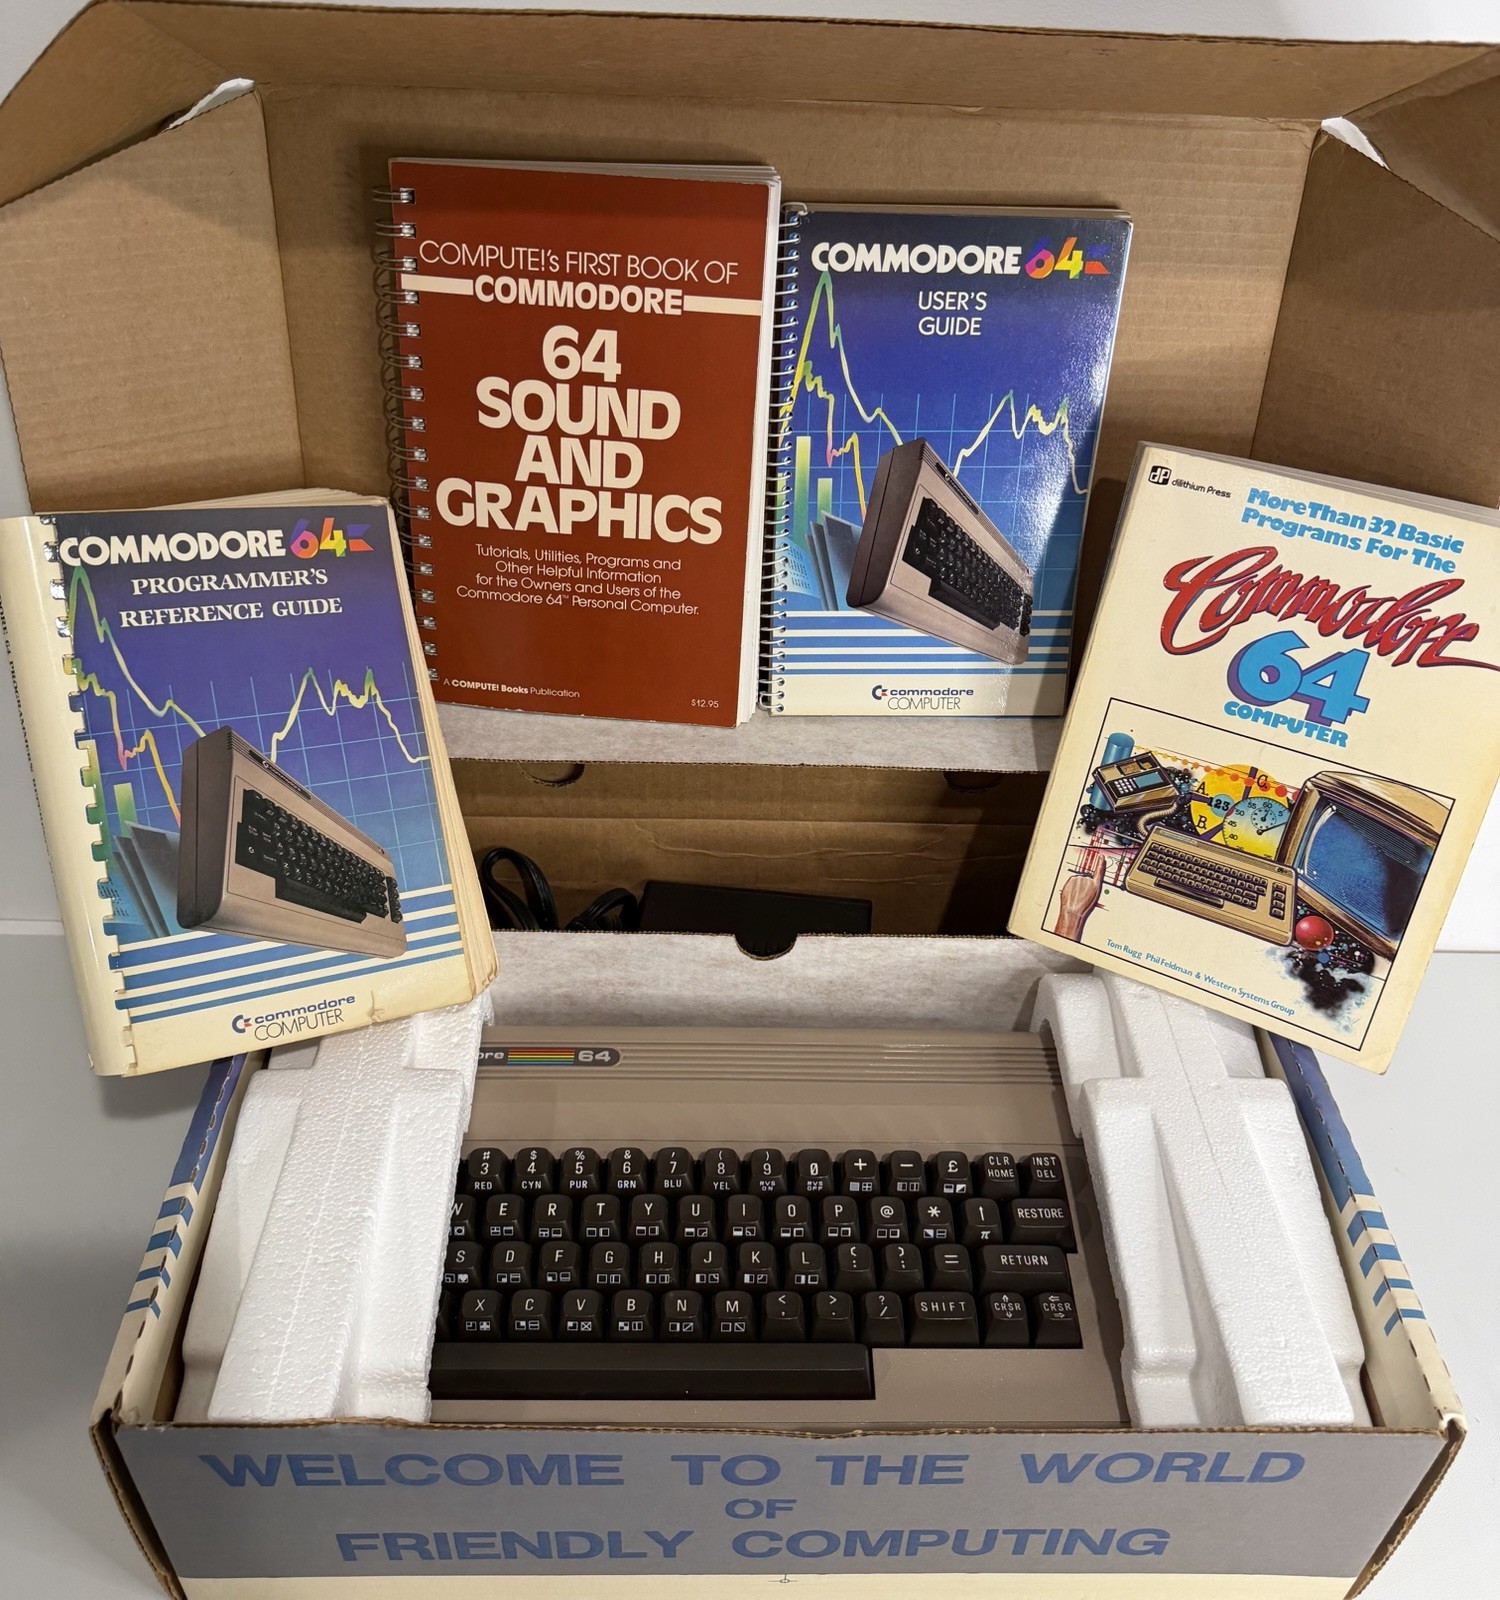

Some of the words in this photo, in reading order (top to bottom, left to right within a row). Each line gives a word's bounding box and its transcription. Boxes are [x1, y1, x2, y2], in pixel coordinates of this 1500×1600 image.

[419, 239, 560, 273] COMPUTE!'s
[566, 250, 622, 277] FIRST
[627, 256, 699, 283] BOOK
[703, 260, 739, 285] OF
[811, 242, 1022, 276] COMMODORE
[1024, 235, 1084, 280] 64
[474, 274, 683, 316] COMMODORE
[917, 290, 988, 312] USER'S
[918, 316, 982, 337] GUIDE
[542, 324, 622, 383] 64
[476, 375, 682, 441] SOUND
[514, 434, 644, 490] AND
[1171, 478, 1206, 493] dilithium
[1206, 485, 1232, 499] Press
[435, 477, 723, 545] GRAPHICS
[1246, 487, 1307, 516] More
[1307, 501, 1367, 531] Than
[1368, 515, 1397, 538] 32
[1397, 522, 1465, 554] Basic
[58, 528, 287, 567] COMMODORE
[289, 516, 348, 560] 64
[1240, 506, 1362, 551] Programs
[1364, 537, 1408, 561] For
[1411, 547, 1457, 574] The
[475, 543, 531, 561] Tutorials,
[534, 549, 582, 565] Utilities,
[585, 552, 650, 569] Programs
[652, 558, 682, 571] and
[495, 560, 533, 575] Other
[536, 563, 583, 580] Helpful
[586, 567, 662, 584] Information
[130, 567, 329, 597] PROGRAMMER'S
[475, 573, 493, 586] for
[496, 574, 518, 588] the
[521, 577, 572, 593] Owners
[574, 581, 603, 595] and
[606, 584, 641, 598] Users
[643, 586, 658, 599] of
[659, 587, 682, 600] the
[456, 585, 543, 605] Commodore
[571, 595, 627, 611] Personal
[630, 599, 700, 617] Computer.
[118, 601, 265, 629] REFERENCE
[271, 597, 344, 618] GUIDE
[1159, 545, 1500, 671] Commodore
[1226, 630, 1371, 727] 64
[443, 678, 450, 687] A
[451, 679, 500, 693] COMPUTE!
[501, 684, 529, 695] Books
[530, 687, 580, 699] Publication
[889, 687, 974, 697] commodore
[690, 698, 719, 710] $12.95
[887, 696, 961, 711] COMPUTER
[1223, 700, 1350, 748] COMPUTER
[1207, 796, 1231, 812] 123
[1106, 938, 1123, 951] Tom
[1122, 944, 1143, 960] Rugg
[1145, 952, 1161, 965] Phil
[1160, 958, 1193, 977] Feldman
[1194, 971, 1201, 980] &
[1203, 973, 1237, 994] Western
[1237, 987, 1270, 1007] Systems
[1270, 1000, 1296, 1017] Group
[254, 995, 356, 1025] commodore
[254, 1008, 345, 1042] COMPUTER
[577, 1050, 611, 1063] 64
[482, 1151, 491, 1160] #
[530, 1150, 538, 1160] $
[575, 1150, 585, 1161] %
[624, 1150, 632, 1159] &
[988, 1156, 1010, 1166] CLR
[527, 1162, 537, 1174] 4
[575, 1162, 584, 1174] 5
[622, 1161, 631, 1174] 6
[669, 1161, 678, 1174] 7
[717, 1162, 726, 1174] 8
[947, 1160, 959, 1173] £
[1032, 1156, 1057, 1167] INST
[480, 1162, 489, 1175] 3
[763, 1162, 772, 1176] 9
[987, 1168, 1015, 1178] HOME
[1036, 1169, 1056, 1179] DEL
[474, 1181, 493, 1190] RED
[521, 1180, 542, 1190] CYN
[569, 1180, 588, 1189] PUR
[617, 1180, 637, 1189] GRN
[663, 1179, 682, 1188] BLU
[712, 1181, 730, 1191] YEL
[499, 1202, 508, 1216] E
[547, 1203, 557, 1216] R
[596, 1202, 605, 1216] T
[644, 1203, 653, 1215] Y
[691, 1203, 700, 1216] U
[742, 1203, 746, 1216] I
[787, 1204, 796, 1217] O
[834, 1204, 843, 1217] P
[880, 1205, 894, 1218] @
[1017, 1208, 1064, 1219] RESTORE
[455, 1250, 466, 1263] S
[505, 1250, 515, 1263] D
[555, 1250, 564, 1262] F
[605, 1251, 614, 1264] G
[654, 1251, 663, 1264] H
[703, 1251, 712, 1263] J
[751, 1251, 760, 1263] K
[801, 1251, 810, 1264] L
[1000, 1254, 1049, 1266] RETURN
[475, 1299, 486, 1311] X
[525, 1298, 534, 1311] C
[576, 1299, 586, 1311] V
[627, 1298, 636, 1312] B
[676, 1299, 687, 1312] N
[726, 1300, 739, 1313] M
[920, 1301, 966, 1312] SHIFT
[994, 1302, 1022, 1311] CRSR
[1042, 1302, 1072, 1312] CRSR
[198, 1453, 625, 1487] WELCOME
[670, 1453, 782, 1486] TO
[815, 1453, 969, 1486] THE
[1020, 1451, 1306, 1484] WORLD
[725, 1498, 797, 1519] OF
[335, 1530, 695, 1562] FRIENDLY
[731, 1528, 1171, 1559] COMPUTING
